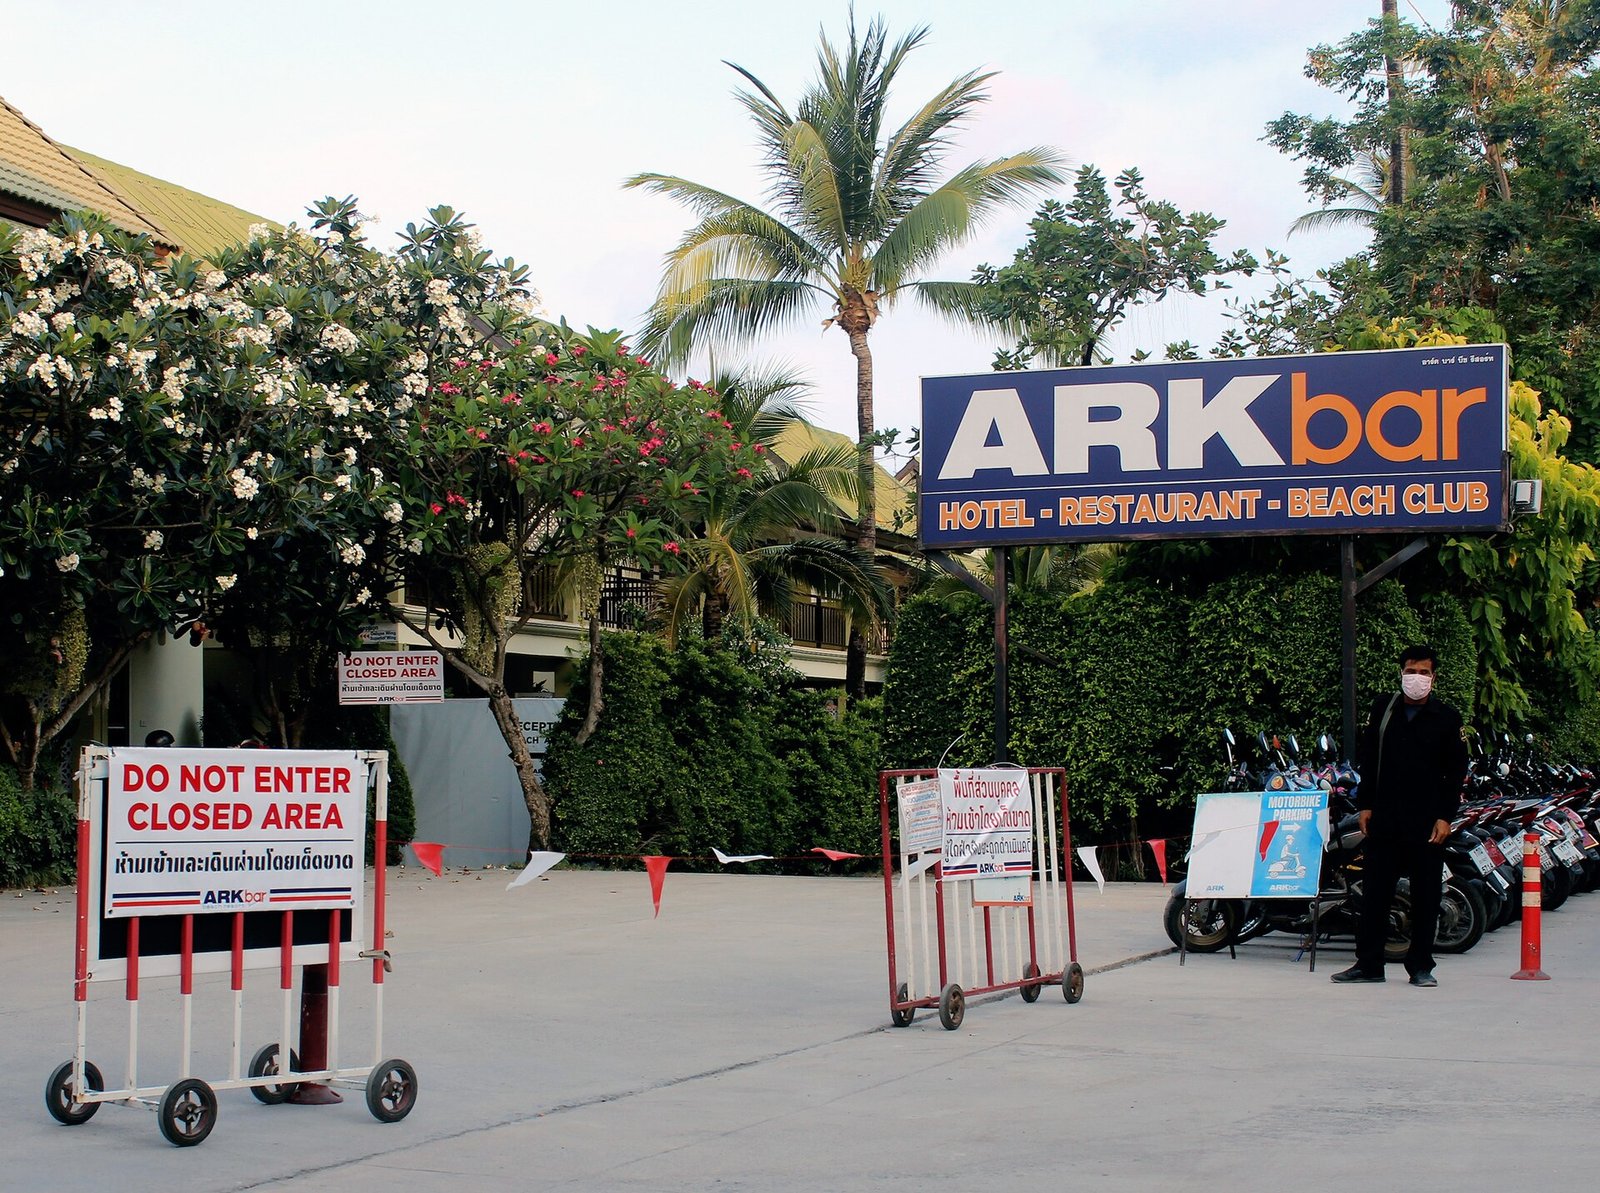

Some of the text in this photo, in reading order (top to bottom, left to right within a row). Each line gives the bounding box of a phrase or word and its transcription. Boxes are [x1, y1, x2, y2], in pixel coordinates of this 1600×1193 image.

[938, 373, 1487, 480] ARKbar
[939, 500, 1035, 531] HOTEL
[1059, 490, 1262, 526] RESTAURANT
[1288, 486, 1395, 517] BEACH
[1403, 481, 1489, 514] CLUB
[343, 655, 439, 667] DO NOT ENTER
[346, 667, 437, 678] CLOSED AREA
[123, 764, 351, 793] DO NOT ENTER
[953, 770, 1020, 805] พื้นที่ส่วนบุคคล
[1268, 795, 1321, 809] MOTORBIKE
[1273, 808, 1313, 822] PARKING
[127, 802, 343, 831] CLOSED AREA
[115, 847, 354, 874] ห้ามเข้าและเดินผ่านโดยเด็ดขาด
[203, 889, 267, 905] ARKbar
